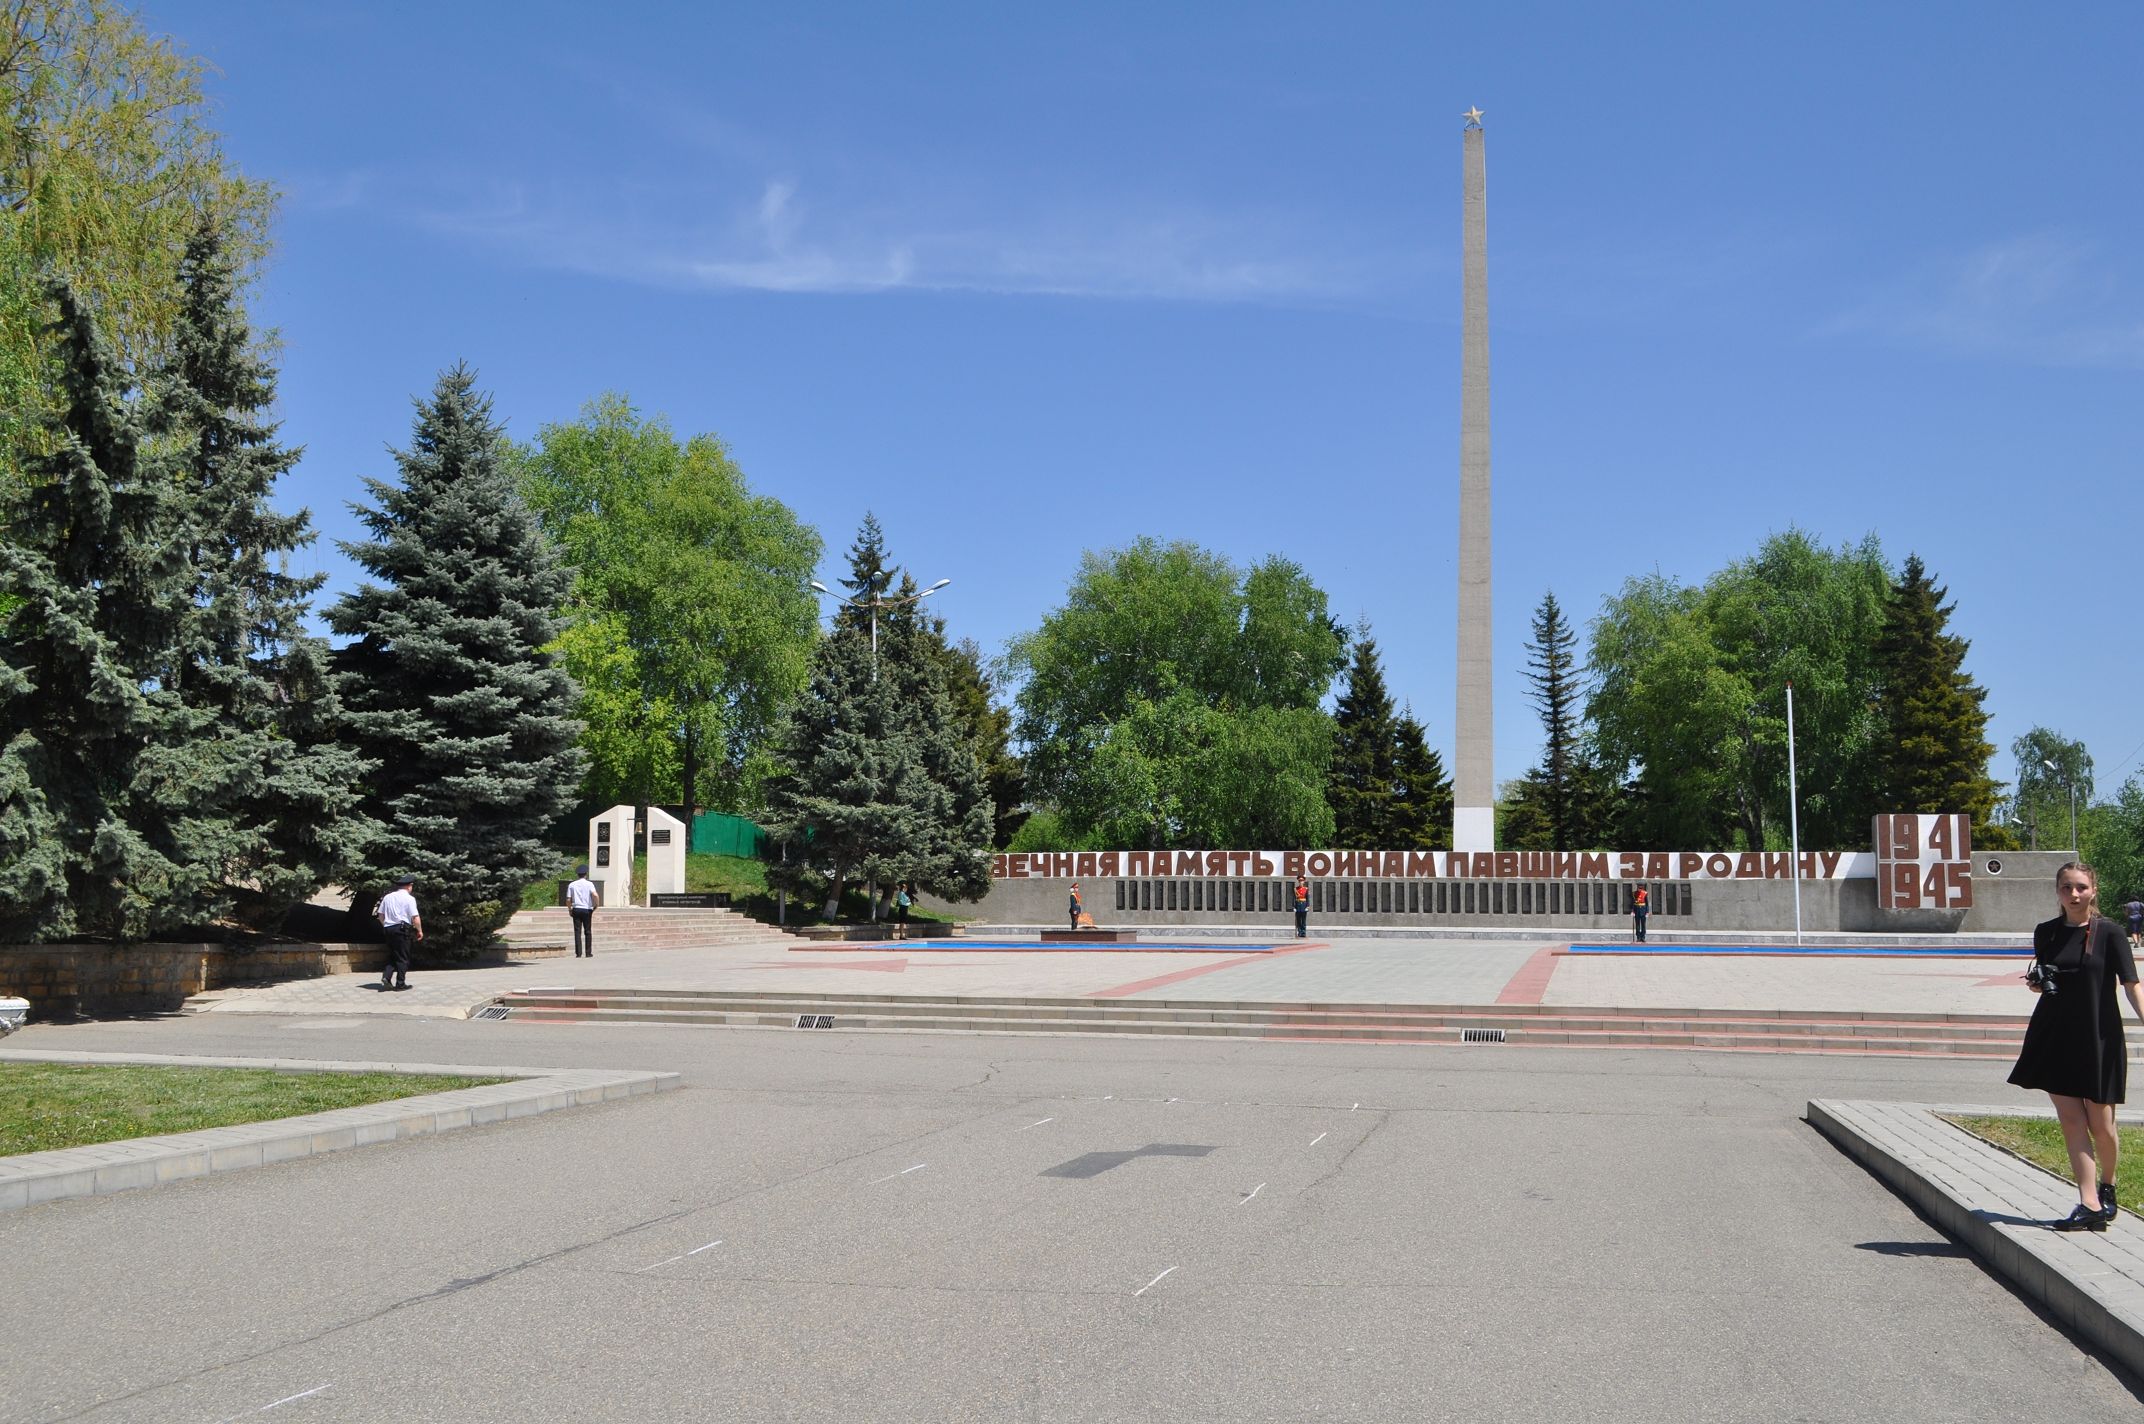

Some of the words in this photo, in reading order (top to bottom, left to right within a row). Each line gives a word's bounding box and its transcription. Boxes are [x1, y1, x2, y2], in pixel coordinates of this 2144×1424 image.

[1878, 813, 1971, 859] 1941
[992, 851, 1119, 877] ВЕЧНАЯ
[1128, 851, 1274, 877] ПАМЯТЬ
[1284, 851, 1437, 877] ВОИНАМ
[1446, 852, 1610, 878] ПАВШИМ
[1620, 853, 1669, 878] ЗА
[1680, 853, 1842, 879] РОДИНУ
[1879, 863, 1973, 908] 1945
